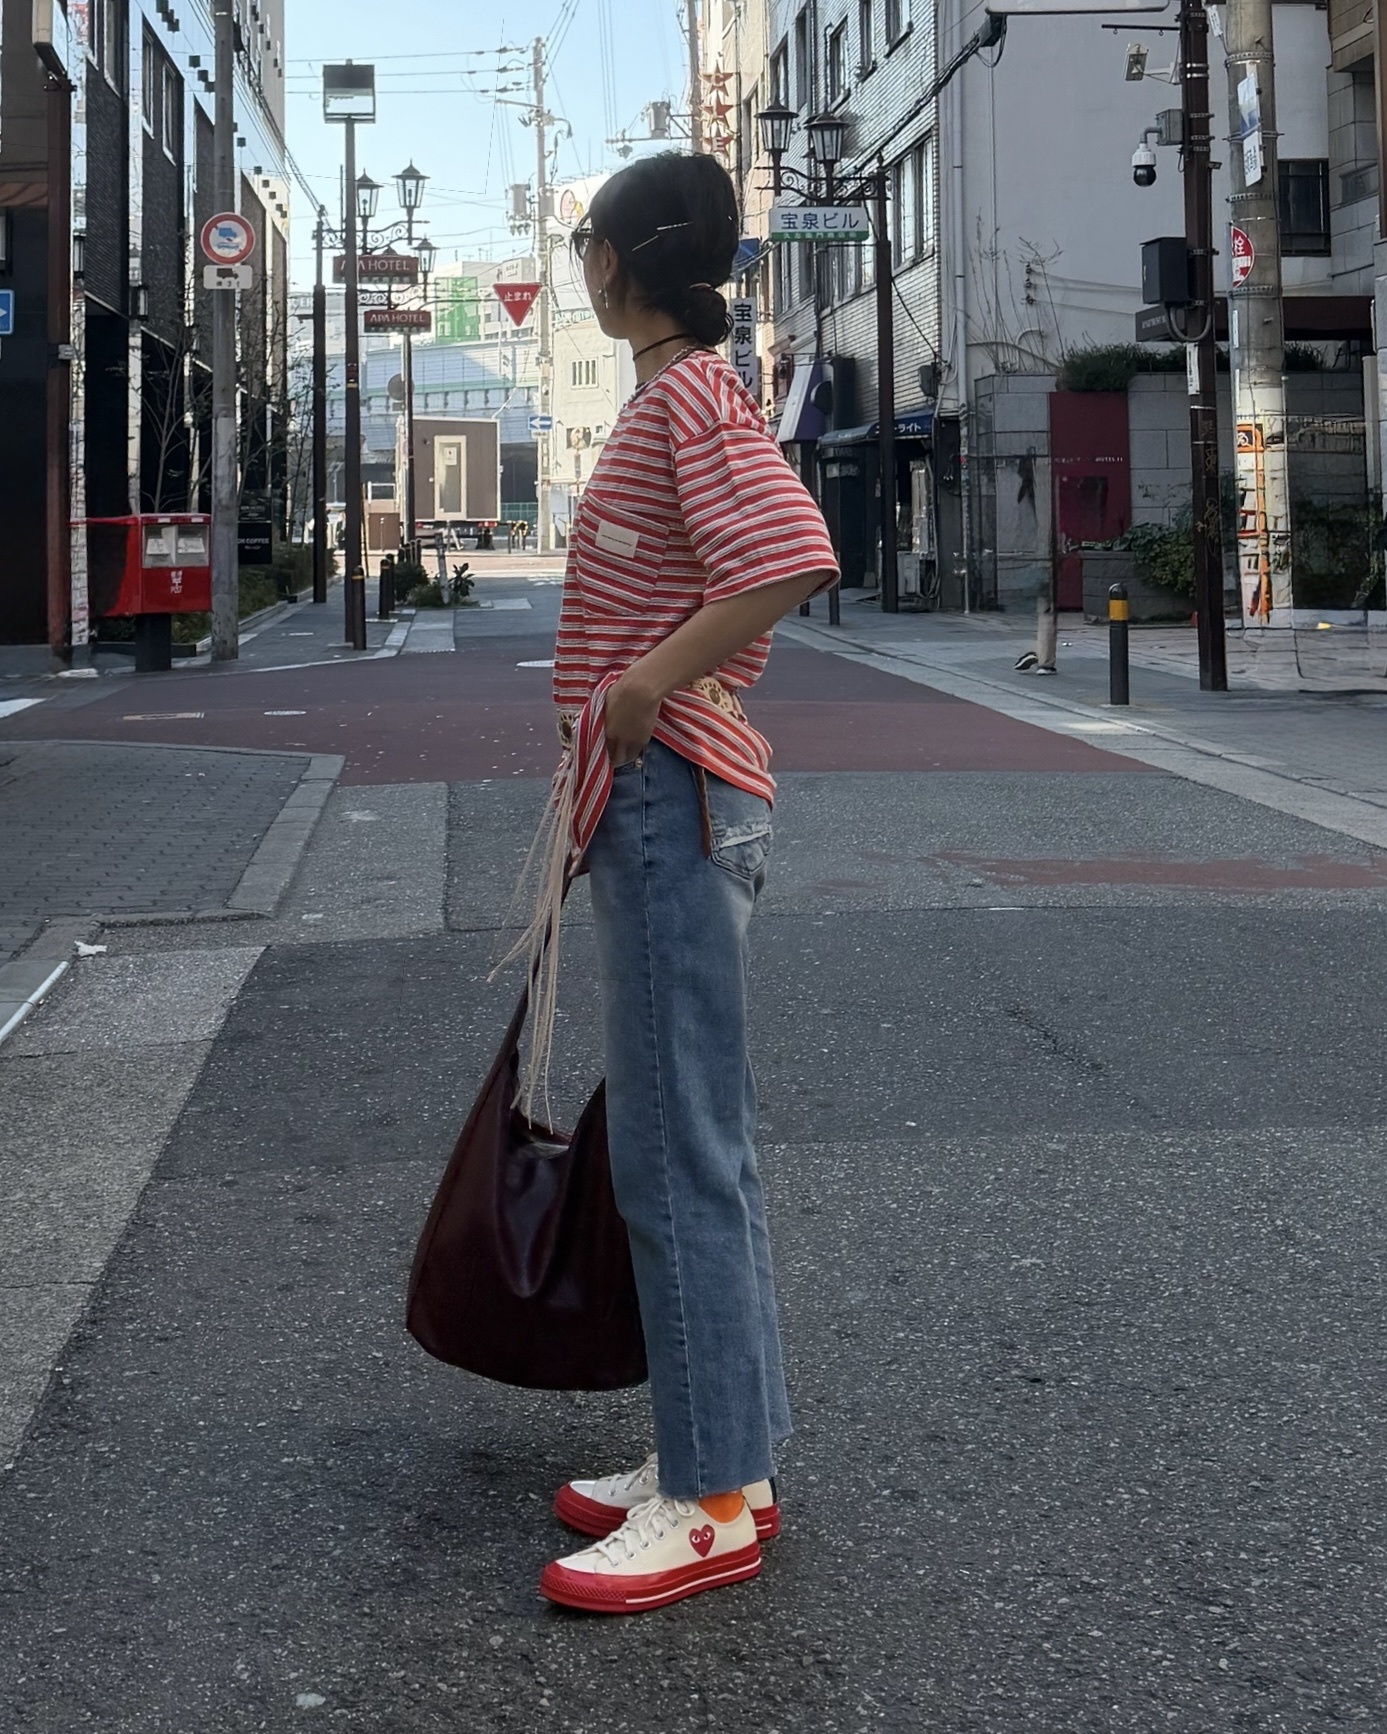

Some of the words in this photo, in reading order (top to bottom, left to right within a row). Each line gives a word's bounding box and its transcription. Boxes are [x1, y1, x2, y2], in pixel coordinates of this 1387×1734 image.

[781, 212, 859, 230] 宝泉ビル
[368, 260, 409, 271] HOTEL
[504, 291, 532, 302] 止まれ
[370, 314, 390, 323] APA
[392, 314, 425, 323] HOTEL
[734, 302, 753, 389] 宝泉ビル
